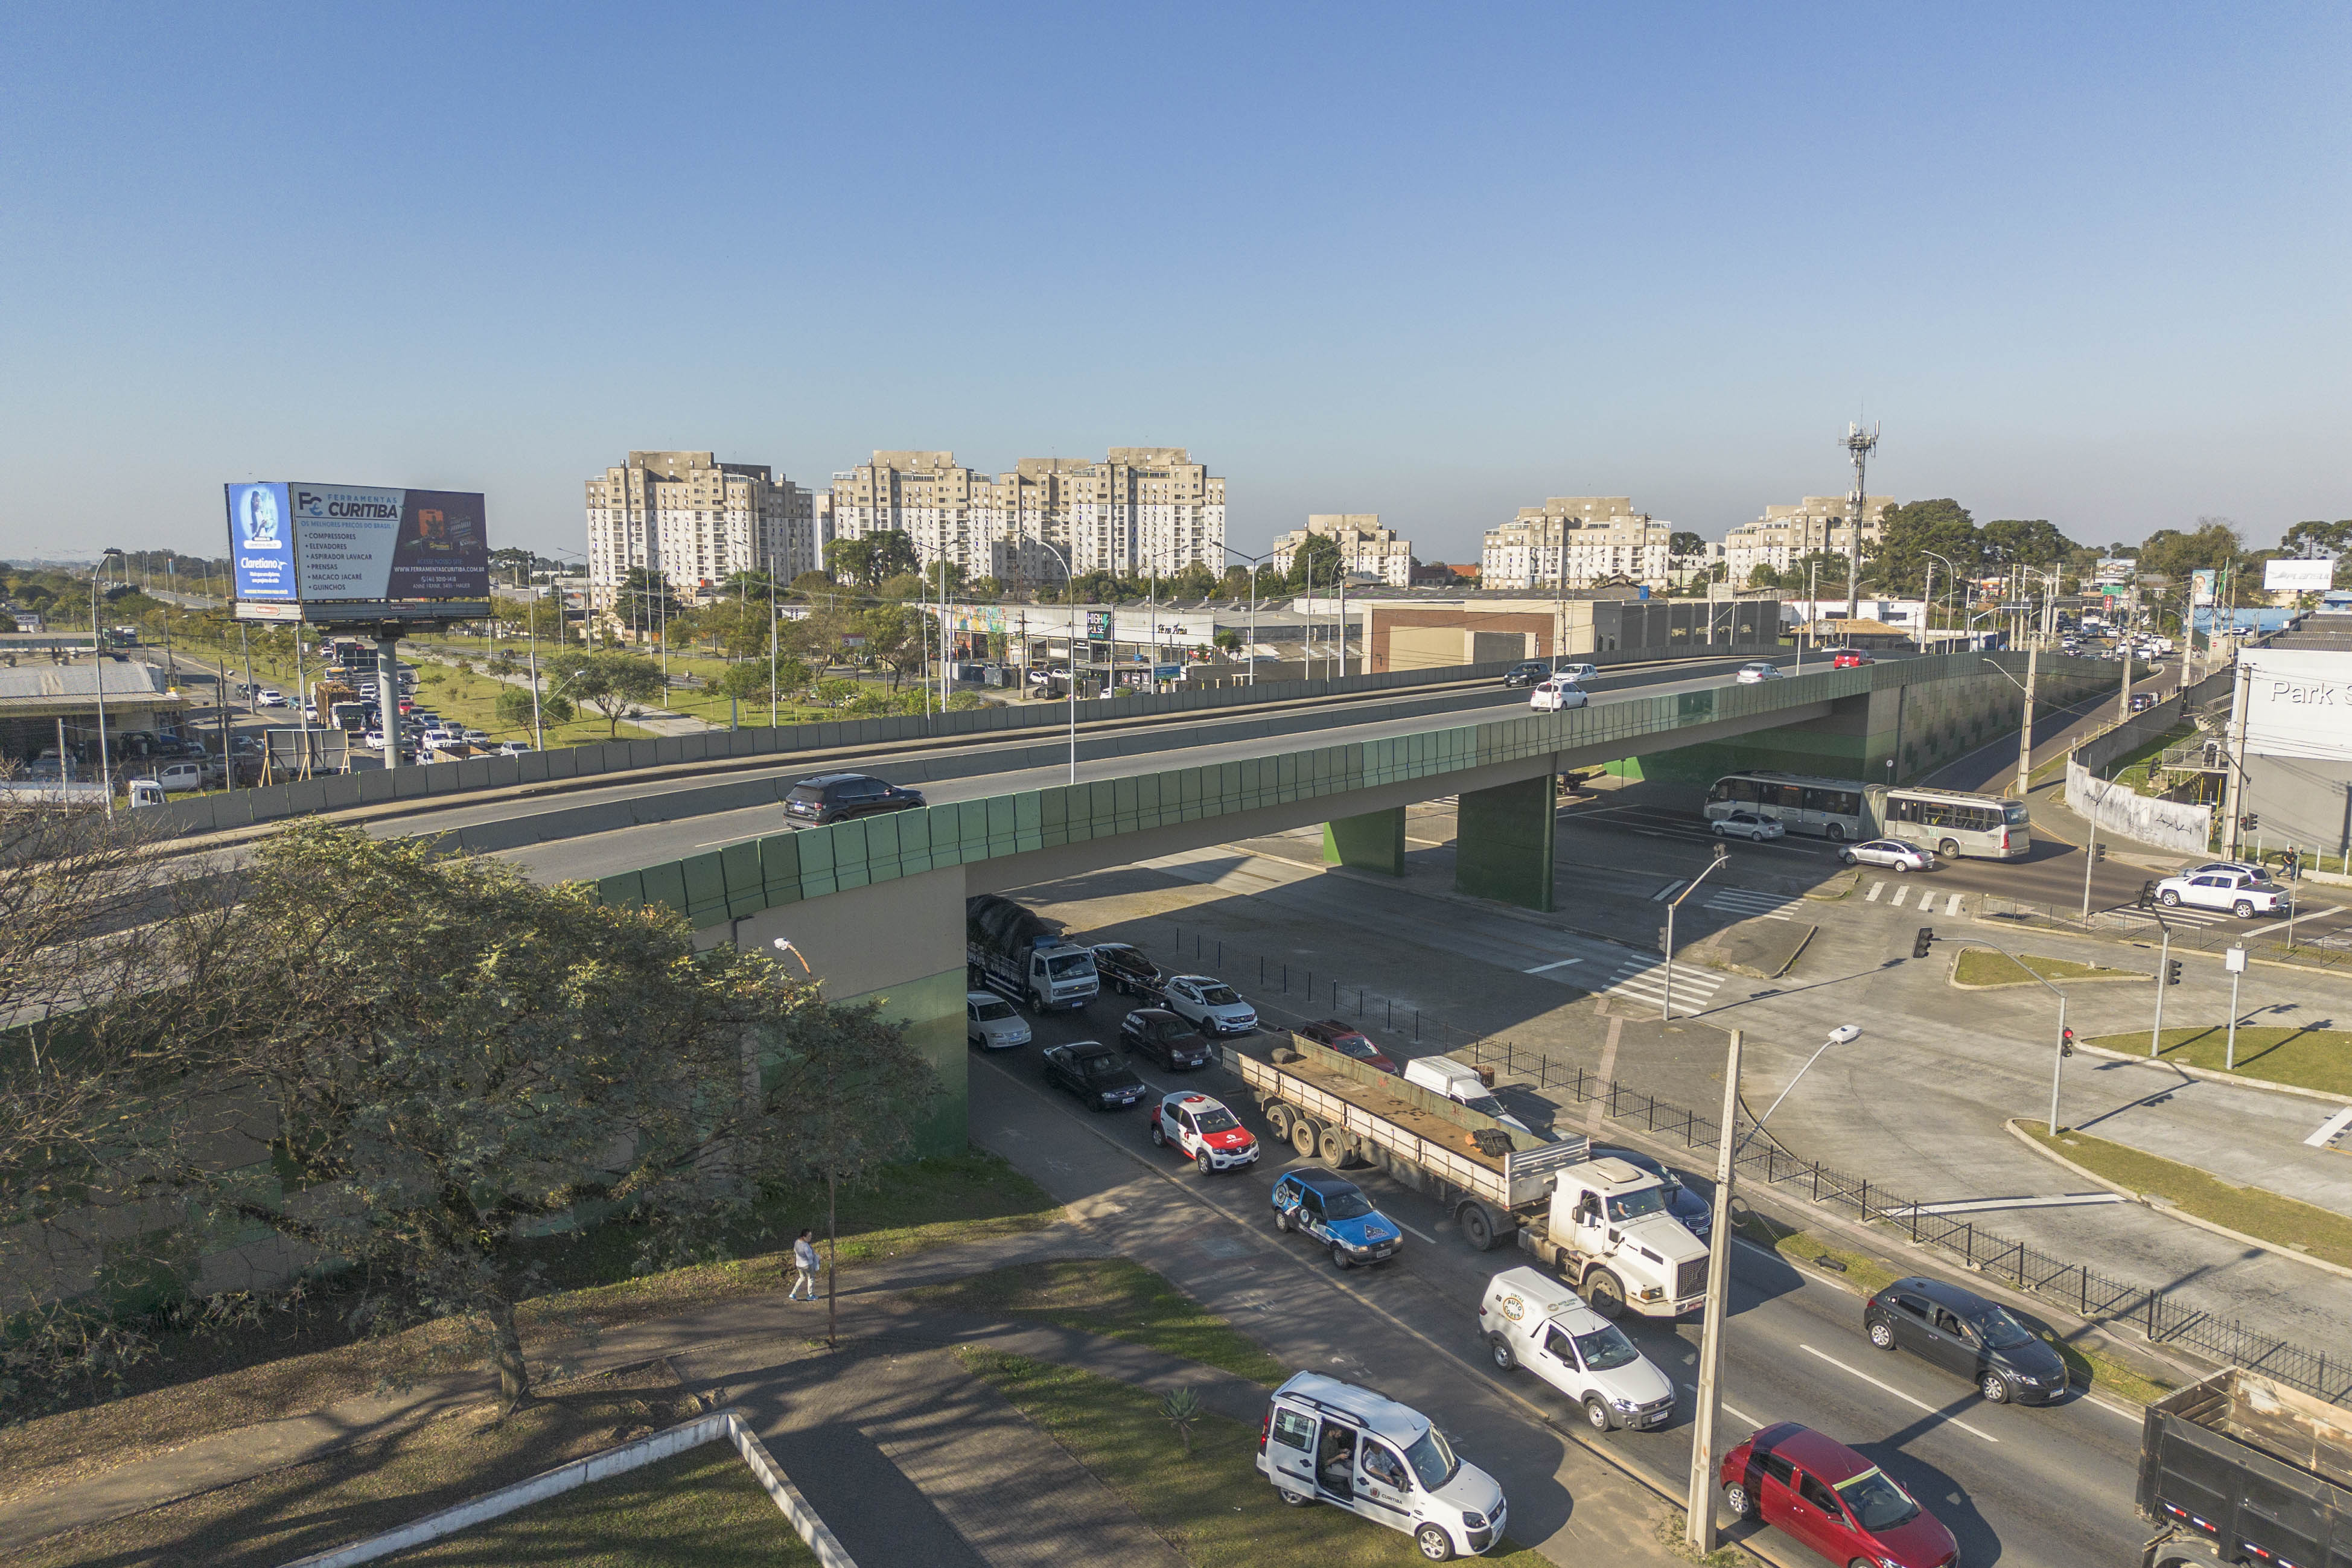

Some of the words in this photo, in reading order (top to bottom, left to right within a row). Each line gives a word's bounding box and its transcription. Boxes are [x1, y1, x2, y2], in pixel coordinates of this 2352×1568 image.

[328, 494, 397, 503] FERRAMENTAS
[328, 502, 398, 518] CURITIBA
[241, 557, 278, 569] Claretiano
[1087, 613, 1103, 624] HIGH
[1088, 625, 1104, 634] PULSE
[2271, 681, 2334, 705] Park
[1511, 1292, 1524, 1303] TINTAS
[1507, 1299, 1522, 1311] AUTO
[1504, 1305, 1520, 1319] CORES
[1381, 1493, 1403, 1505] CURITIBA
